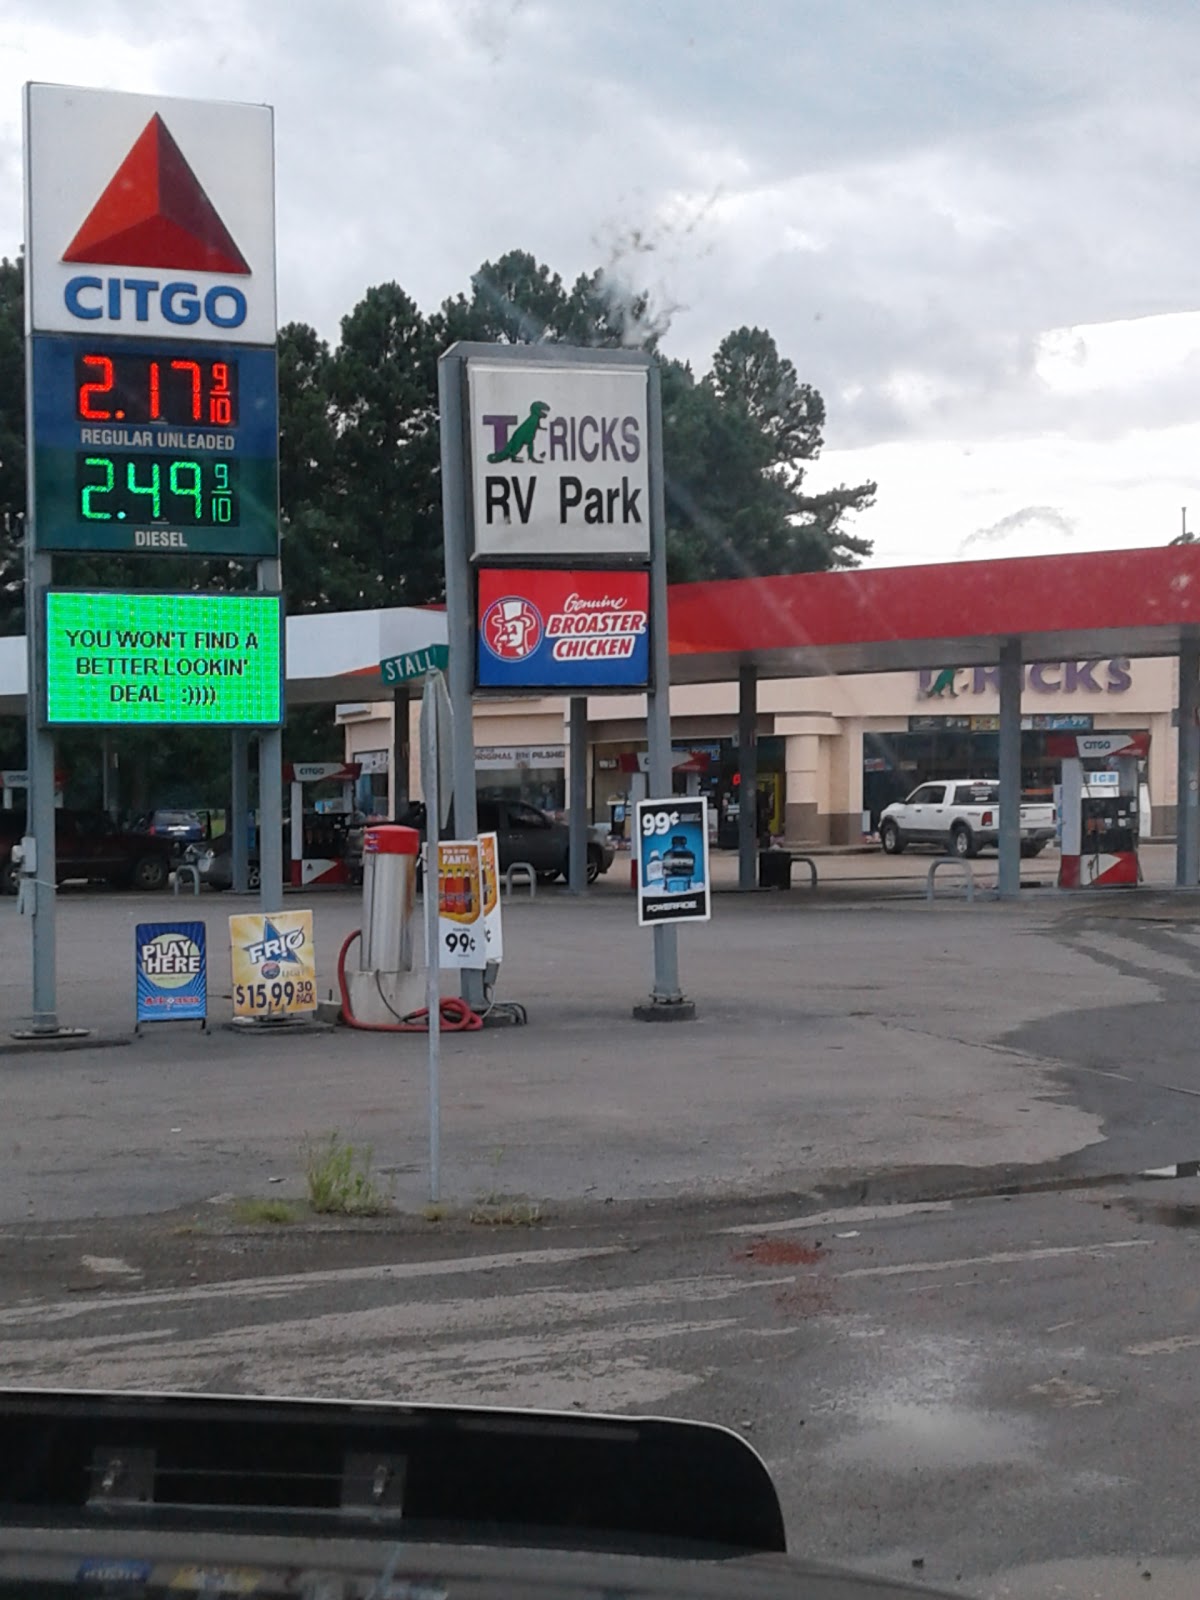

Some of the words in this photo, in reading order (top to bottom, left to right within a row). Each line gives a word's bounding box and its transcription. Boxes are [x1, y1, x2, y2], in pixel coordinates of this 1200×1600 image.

[64, 275, 247, 328] CITGO
[79, 355, 201, 420] 2.17
[81, 428, 153, 447] REGULAR
[157, 433, 235, 450] UNLEADED
[81, 457, 202, 520] 2.49
[485, 475, 537, 524] RV
[559, 475, 642, 525] Park
[134, 530, 188, 548] DIESEL
[564, 592, 628, 613] Genuine
[548, 612, 647, 636] BROASTER
[66, 629, 111, 648] YOU
[116, 630, 187, 649] WON'T
[194, 632, 239, 649] FIND
[245, 632, 259, 650] A
[555, 637, 633, 658] CHICKEN
[76, 656, 158, 676] BETTER
[163, 657, 249, 677] LOOKIN'
[384, 650, 436, 681] STALL
[110, 684, 165, 703] DEAL
[1083, 739, 1111, 749] CITGO
[142, 940, 191, 961] PLAY
[147, 956, 200, 973] HERE
